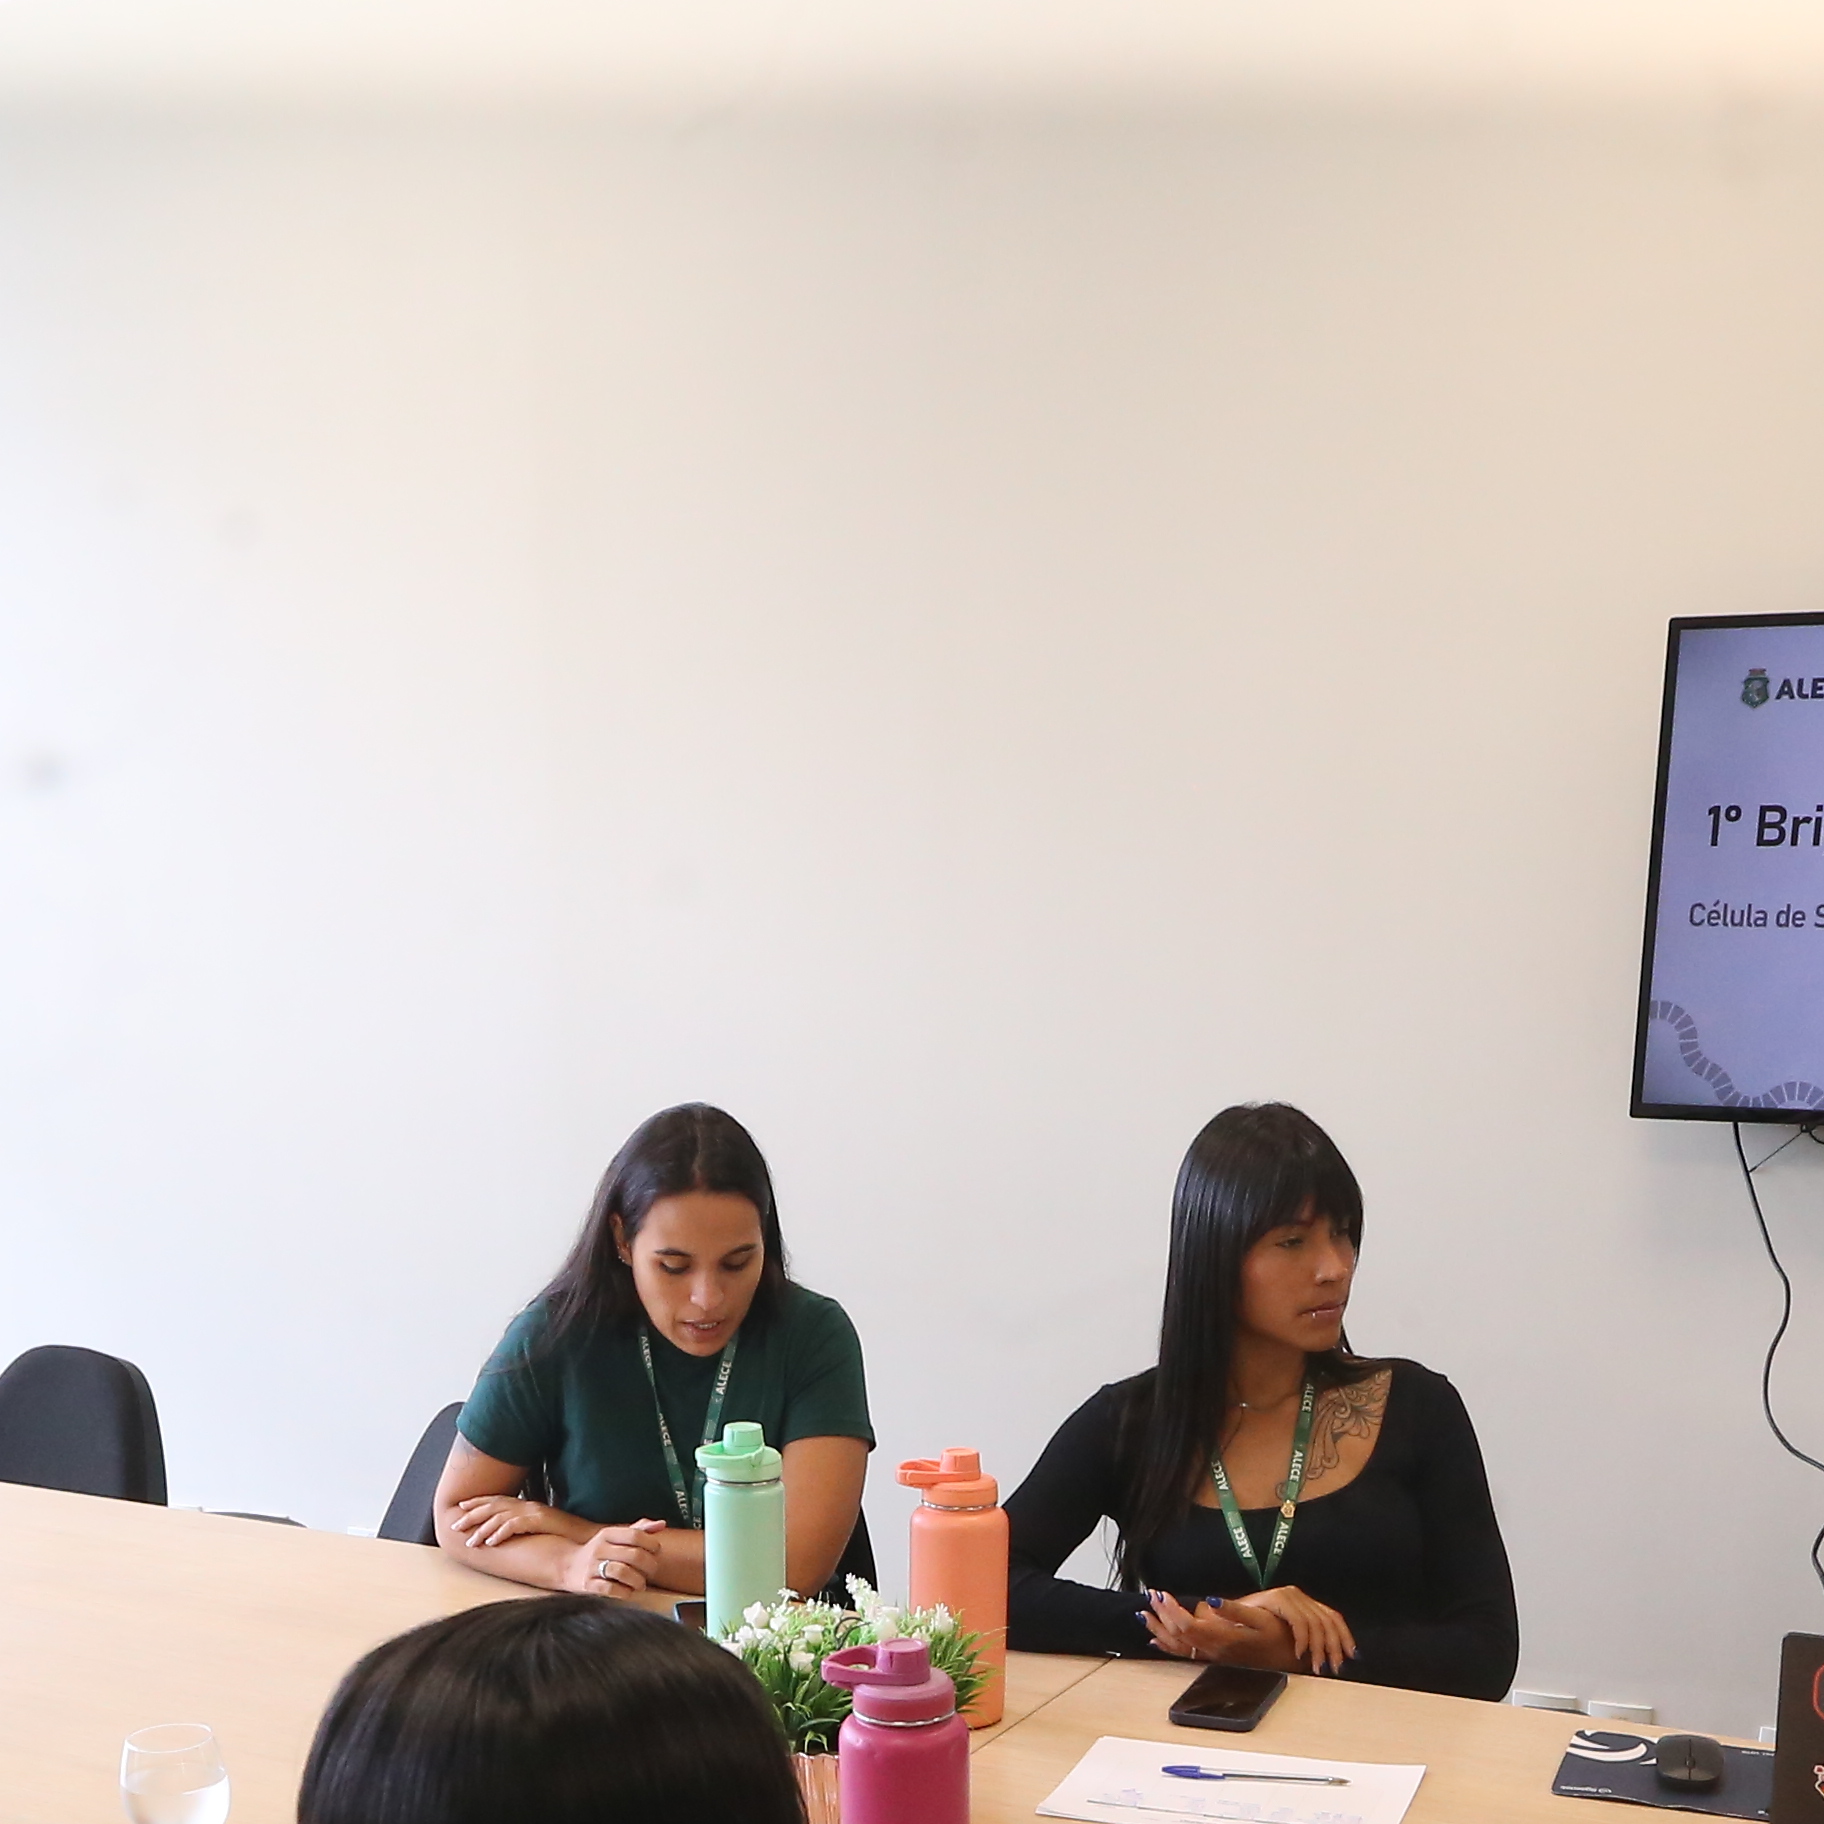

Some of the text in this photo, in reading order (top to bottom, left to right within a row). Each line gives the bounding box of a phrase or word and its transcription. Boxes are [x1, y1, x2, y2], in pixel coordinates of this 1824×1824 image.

[1689, 900, 1768, 928] Célula
[1775, 903, 1806, 928] de
[641, 1336, 652, 1369] ALECE
[716, 1361, 732, 1395] ALECE
[1302, 1383, 1314, 1412] ALECE
[1211, 1460, 1229, 1490] ALECE
[1288, 1449, 1304, 1482] ALECE
[1233, 1526, 1253, 1558] ALECE
[1274, 1521, 1290, 1555] ALECE
